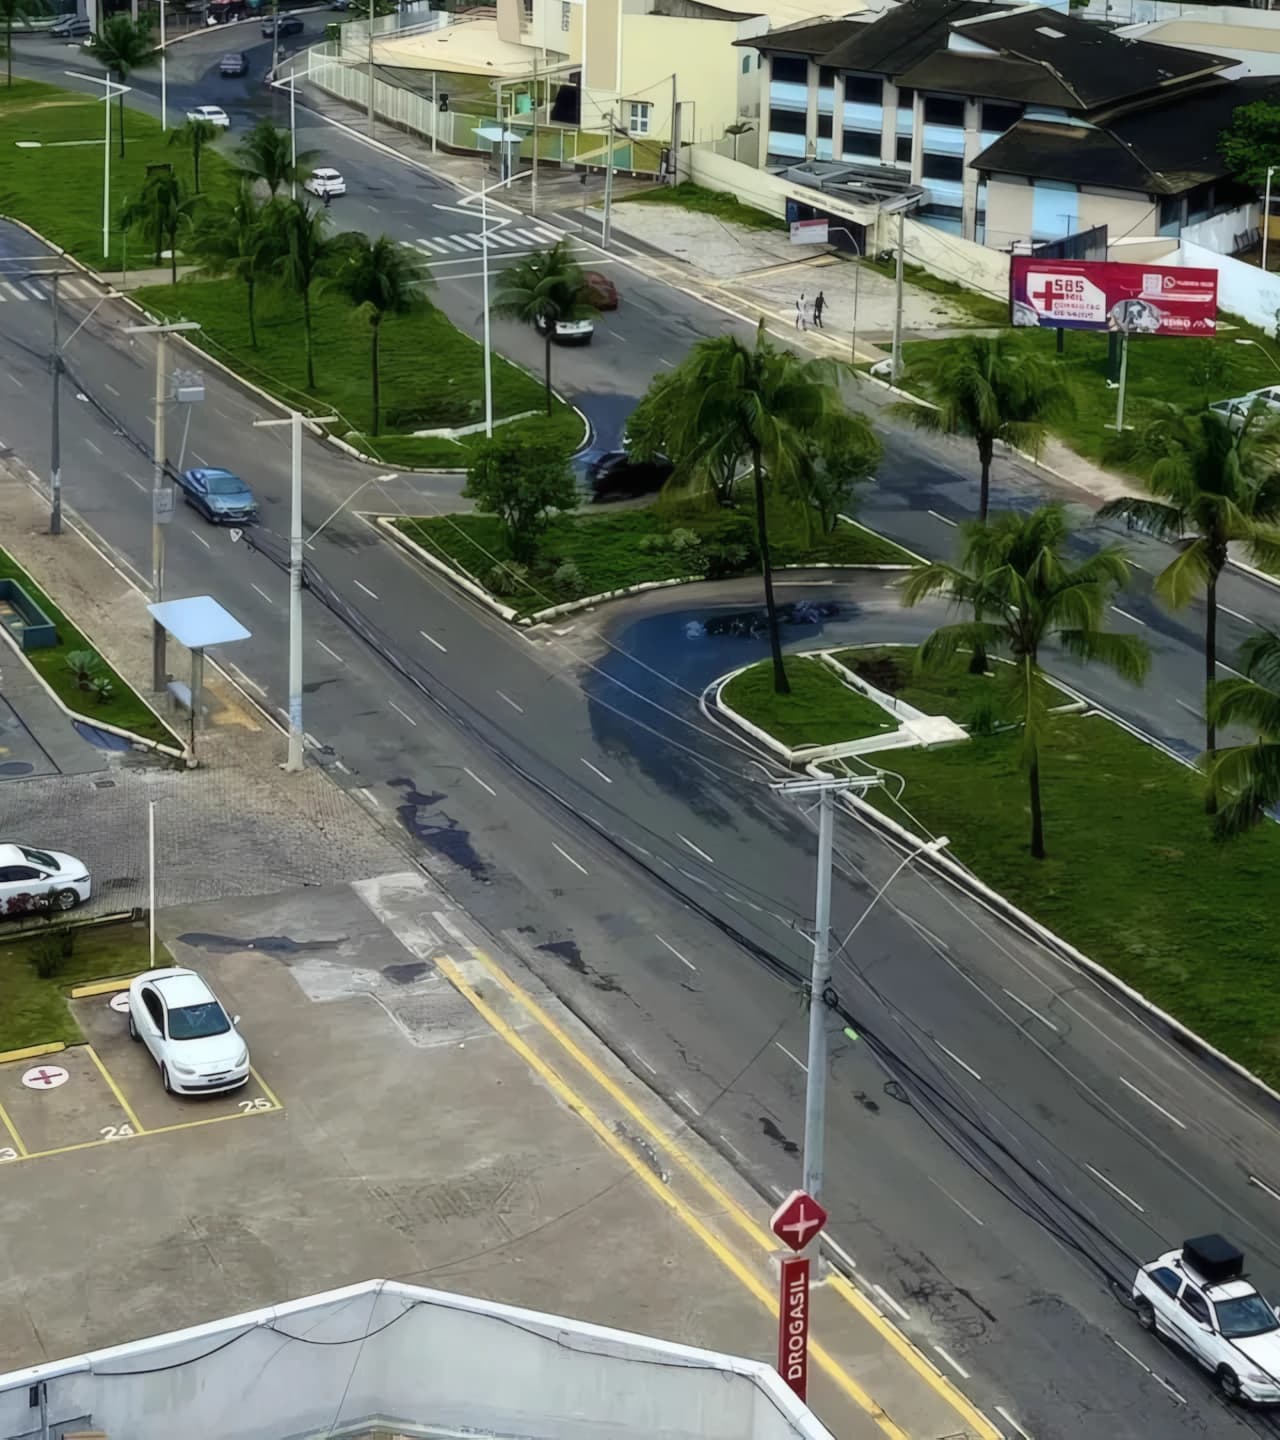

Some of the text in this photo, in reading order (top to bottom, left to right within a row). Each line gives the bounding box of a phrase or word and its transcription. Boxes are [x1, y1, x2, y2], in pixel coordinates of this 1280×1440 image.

[1054, 279, 1084, 293] 585
[238, 1097, 273, 1114] 25
[99, 1123, 135, 1141] 24
[788, 1271, 806, 1381] DROGASIL
